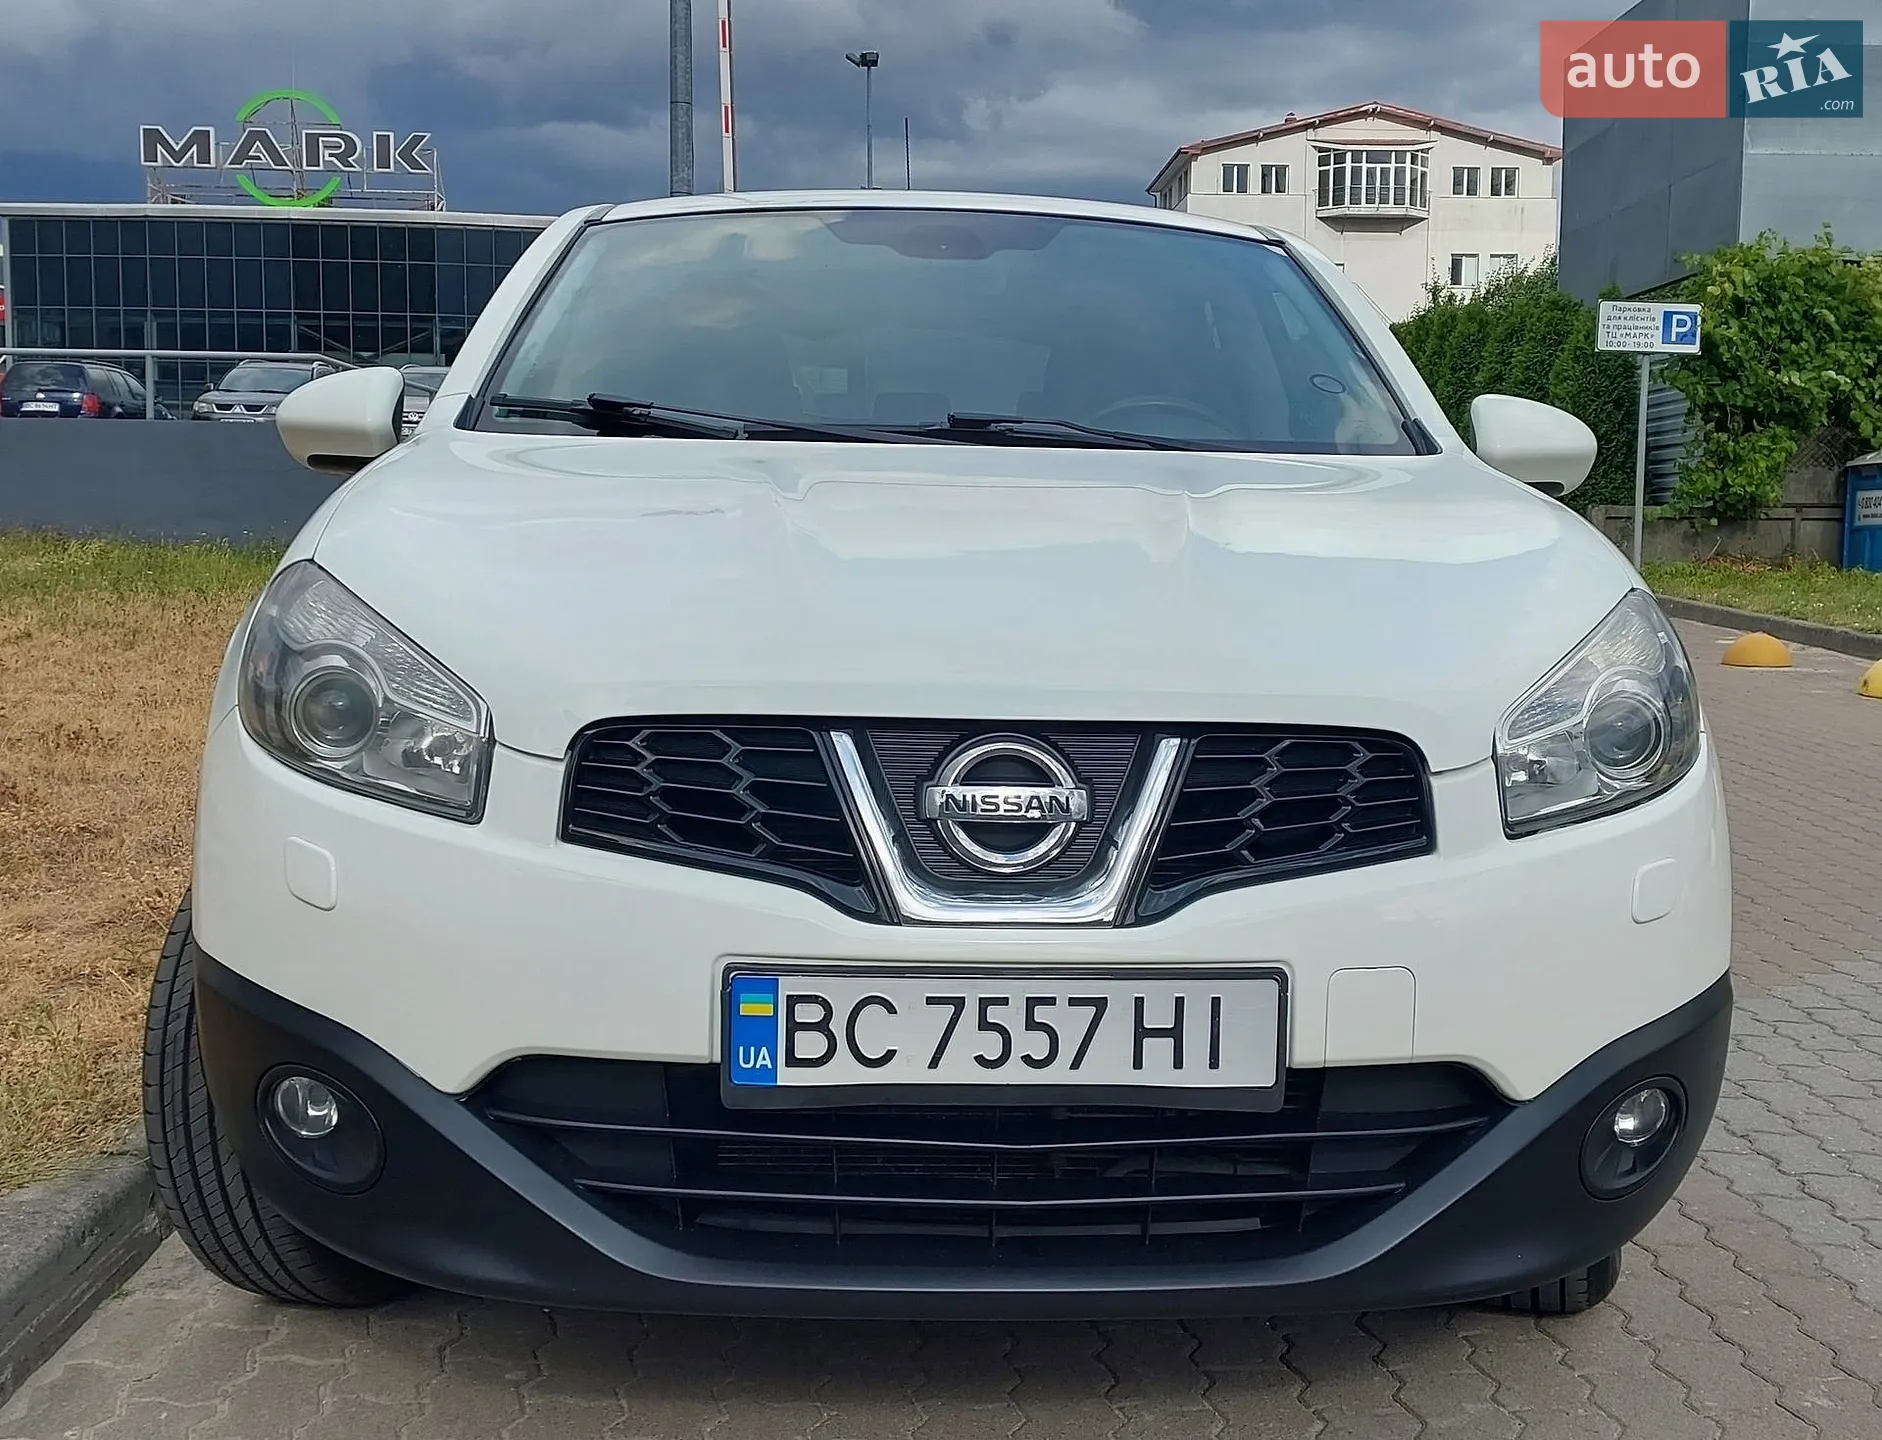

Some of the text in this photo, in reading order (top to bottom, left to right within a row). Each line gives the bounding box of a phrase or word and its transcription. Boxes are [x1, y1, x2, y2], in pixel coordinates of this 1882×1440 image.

[140, 124, 434, 174] MARK
[1606, 314, 1622, 322] для
[1611, 304, 1652, 314] Парковка
[1606, 331, 1617, 340] ТЦ
[1670, 314, 1692, 342] P
[943, 792, 1073, 815] NISSAN
[785, 994, 1222, 1071] BC 7557 HI
[738, 1046, 773, 1070] UA
